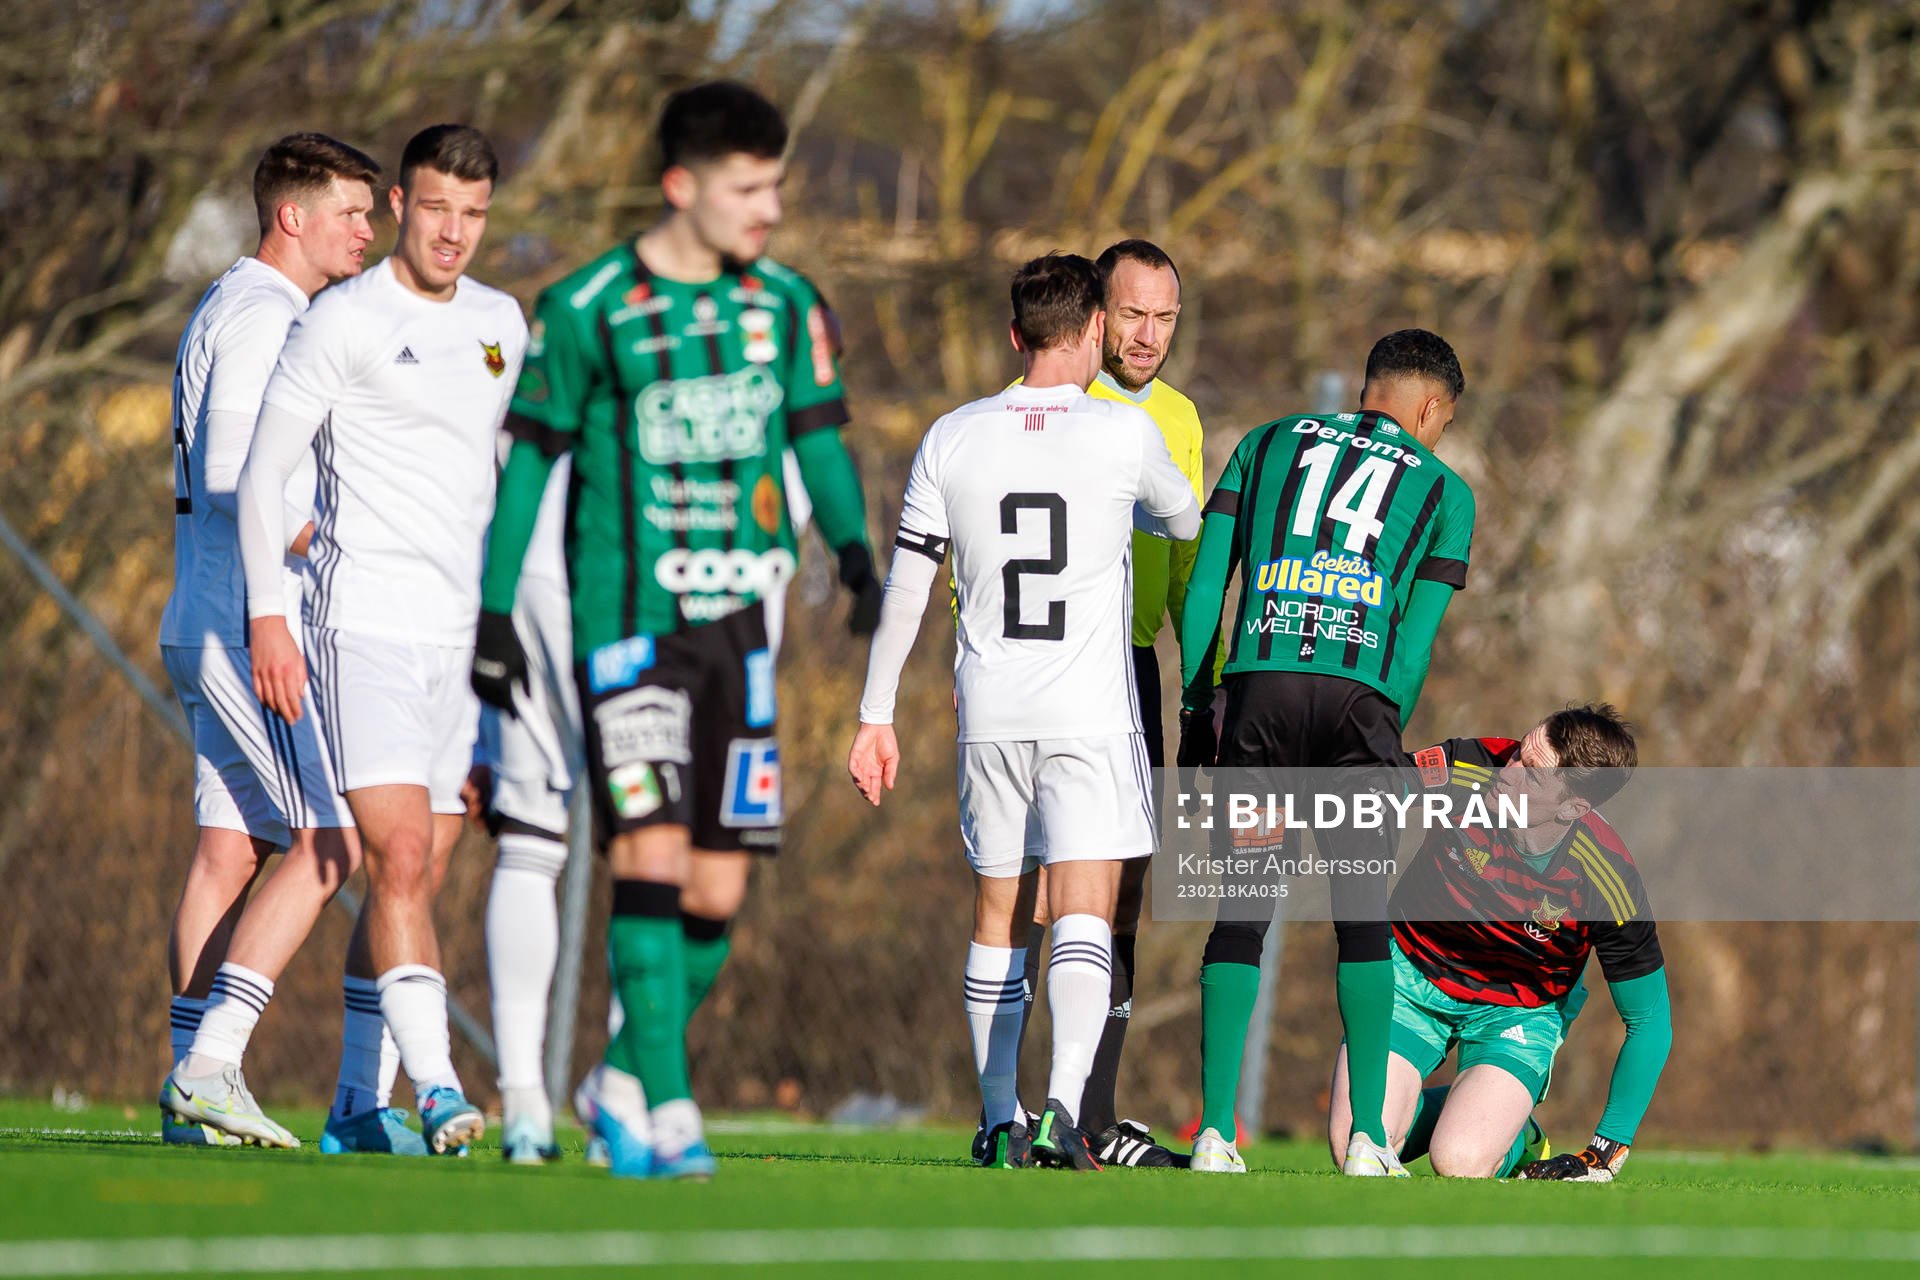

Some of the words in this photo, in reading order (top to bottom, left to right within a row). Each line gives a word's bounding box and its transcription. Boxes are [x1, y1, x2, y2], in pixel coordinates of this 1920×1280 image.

[1292, 419, 1422, 468] Derome
[1292, 441, 1398, 555] 14
[999, 492, 1068, 641] 2
[1311, 550, 1372, 577] Gekås
[1265, 599, 1360, 626] NORDIC
[1246, 617, 1379, 649] WELLNESS
[1465, 847, 1484, 875] adidas
[1500, 1031, 1528, 1045] adidas
